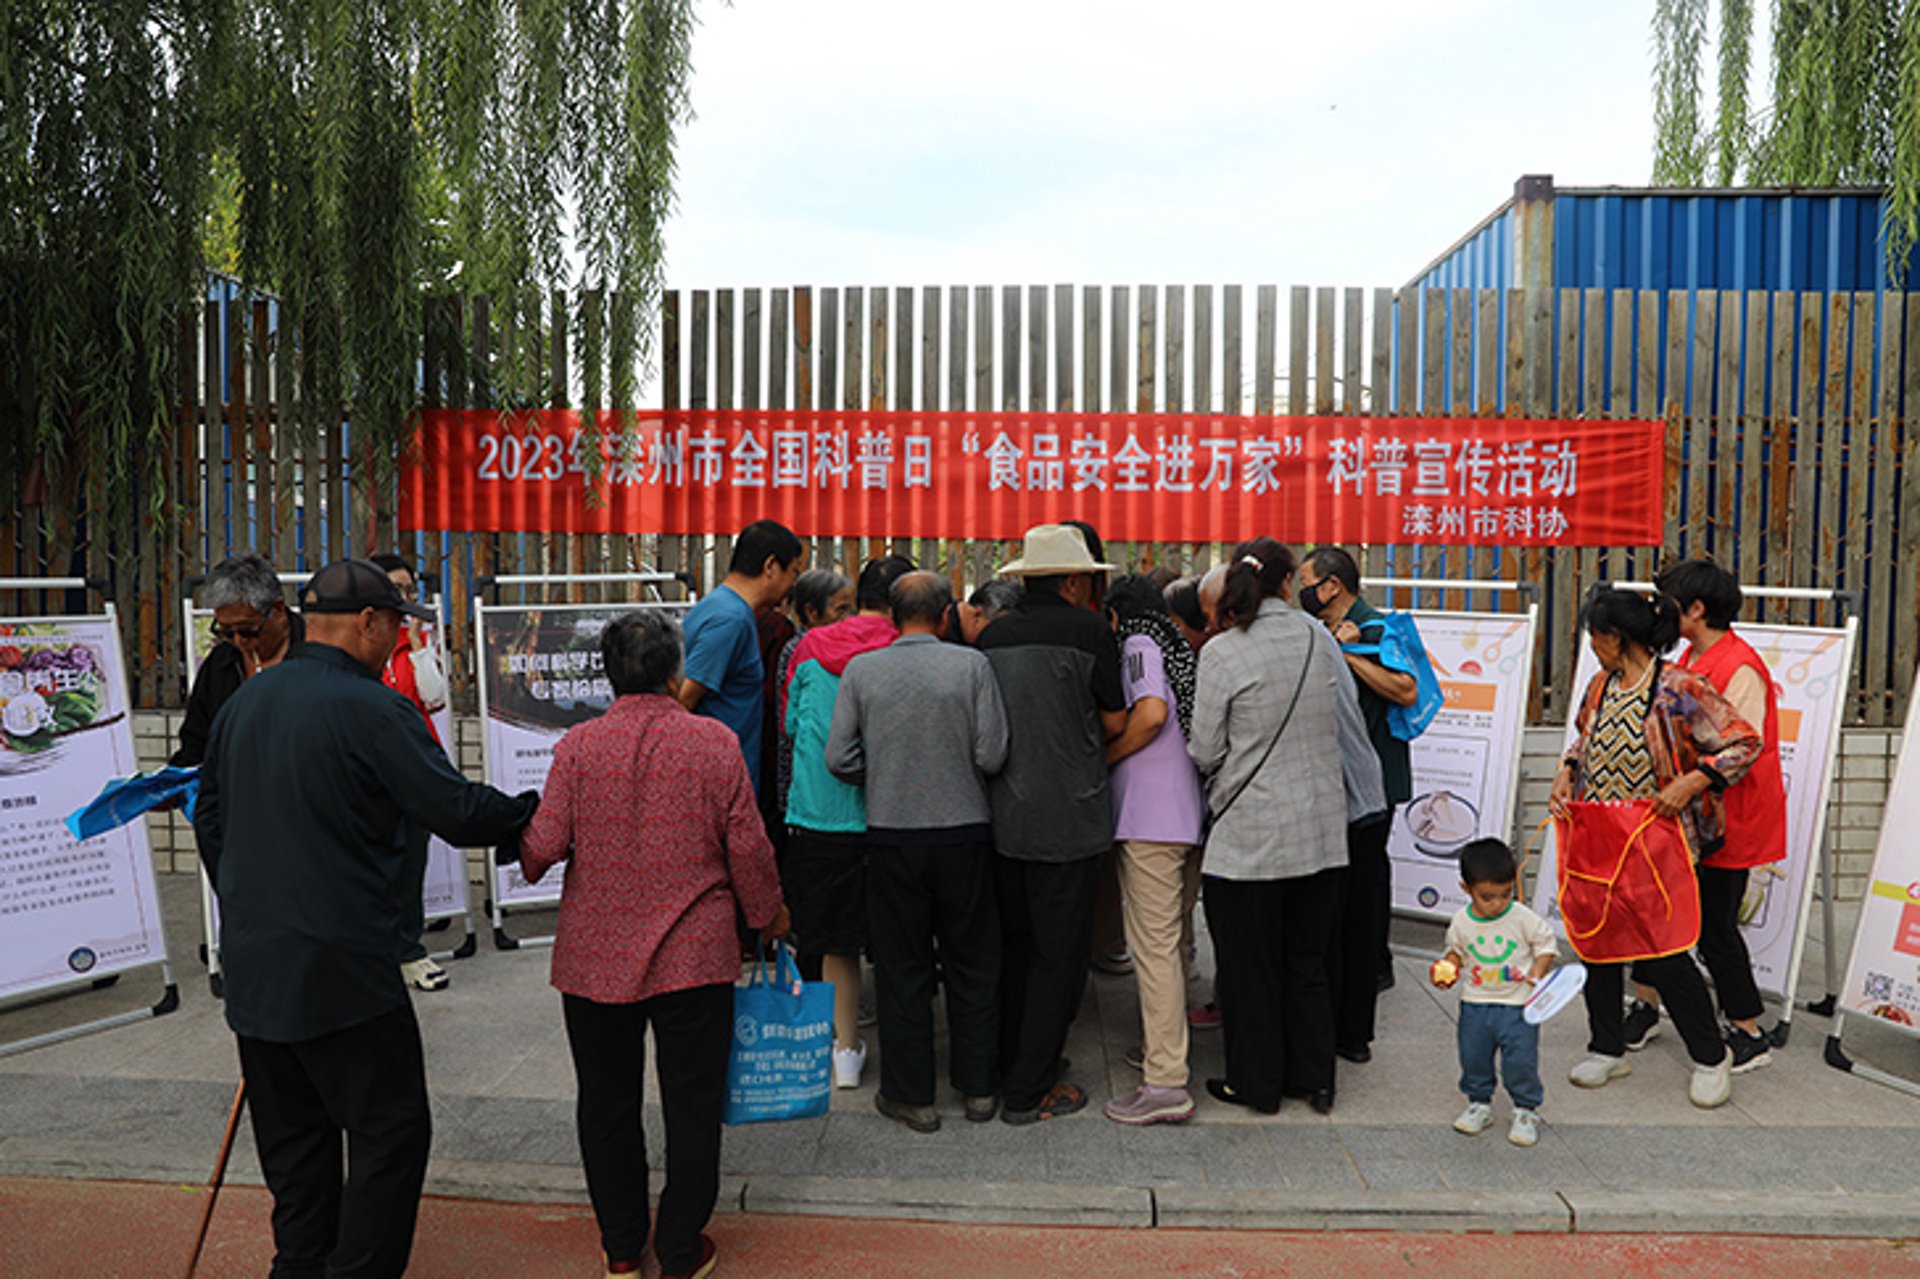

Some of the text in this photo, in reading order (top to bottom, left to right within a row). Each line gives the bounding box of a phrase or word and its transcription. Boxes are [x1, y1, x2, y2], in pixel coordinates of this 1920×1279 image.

[962, 432, 1302, 494] “食品安全进万家”
[1327, 437, 1579, 497] 科普宣传活动
[1402, 504, 1569, 538] 滦州市科协
